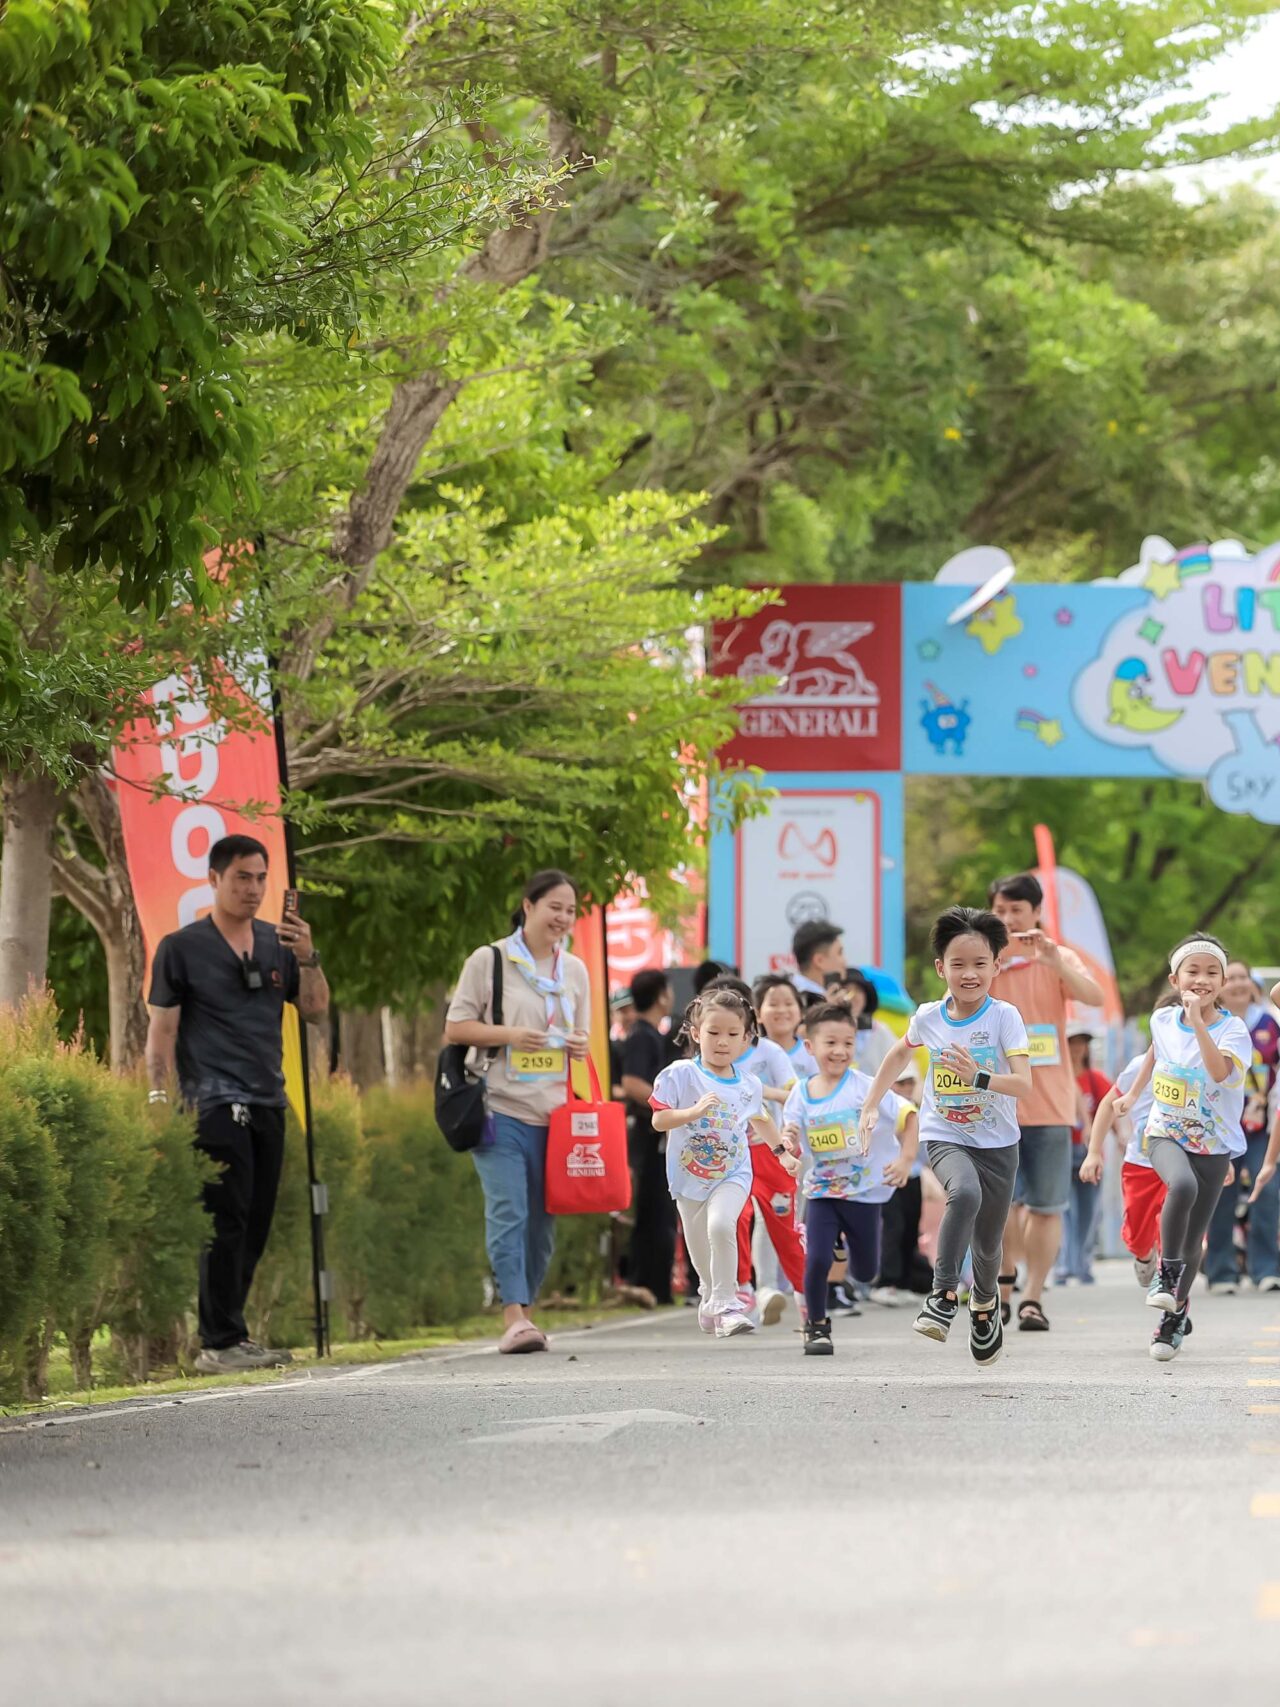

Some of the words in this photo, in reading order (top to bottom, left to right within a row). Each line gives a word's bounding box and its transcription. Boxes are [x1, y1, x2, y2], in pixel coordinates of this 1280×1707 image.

[739, 708, 878, 737] GENERALI
[1226, 770, 1274, 801] SKY
[521, 1056, 553, 1068] 2139
[936, 1073, 973, 1089] 204
[1155, 1081, 1180, 1100] 2139
[1187, 1098, 1197, 1109] A
[809, 1133, 838, 1147] 2140
[847, 1136, 857, 1146] C
